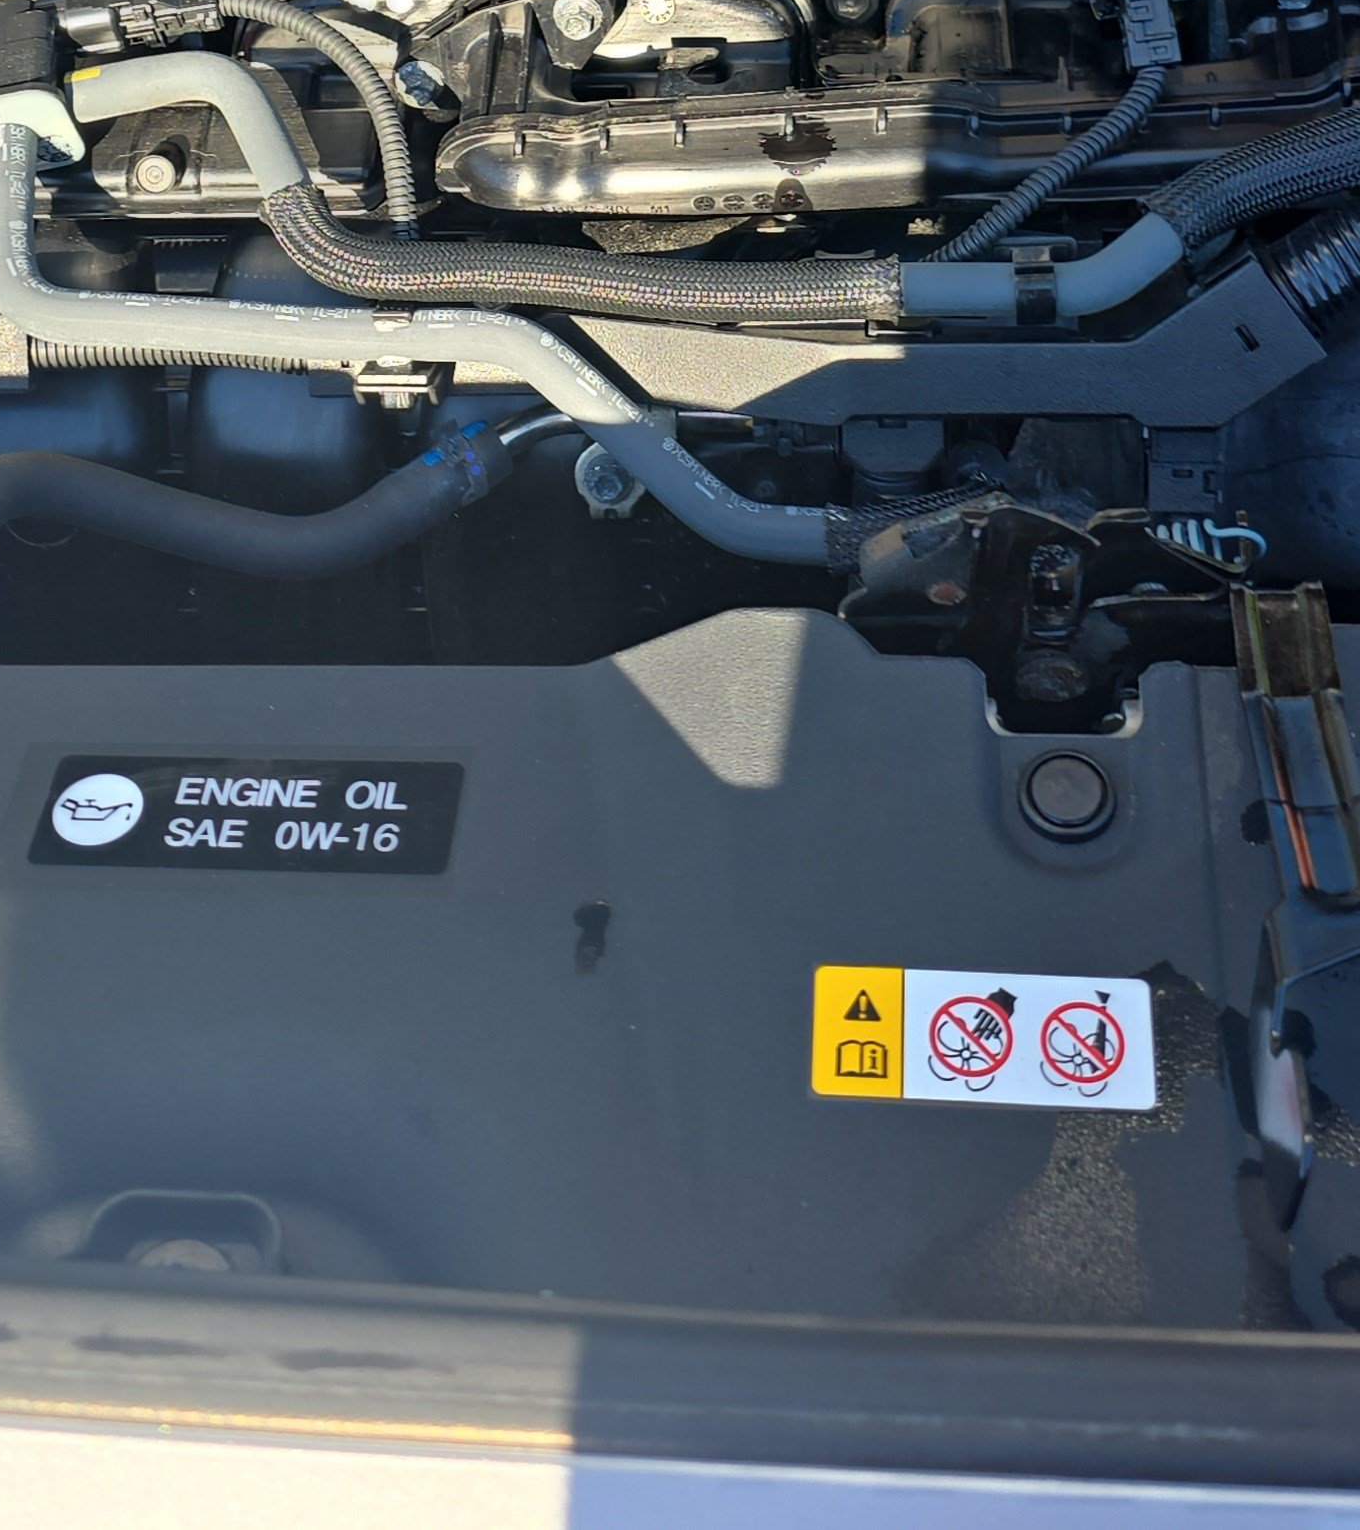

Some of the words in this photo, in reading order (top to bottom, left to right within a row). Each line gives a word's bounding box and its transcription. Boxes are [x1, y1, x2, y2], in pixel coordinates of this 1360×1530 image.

[174, 777, 322, 809] ENGINE
[344, 781, 408, 811] OIL
[164, 818, 249, 849] SAE
[274, 822, 400, 853] 0W-16
